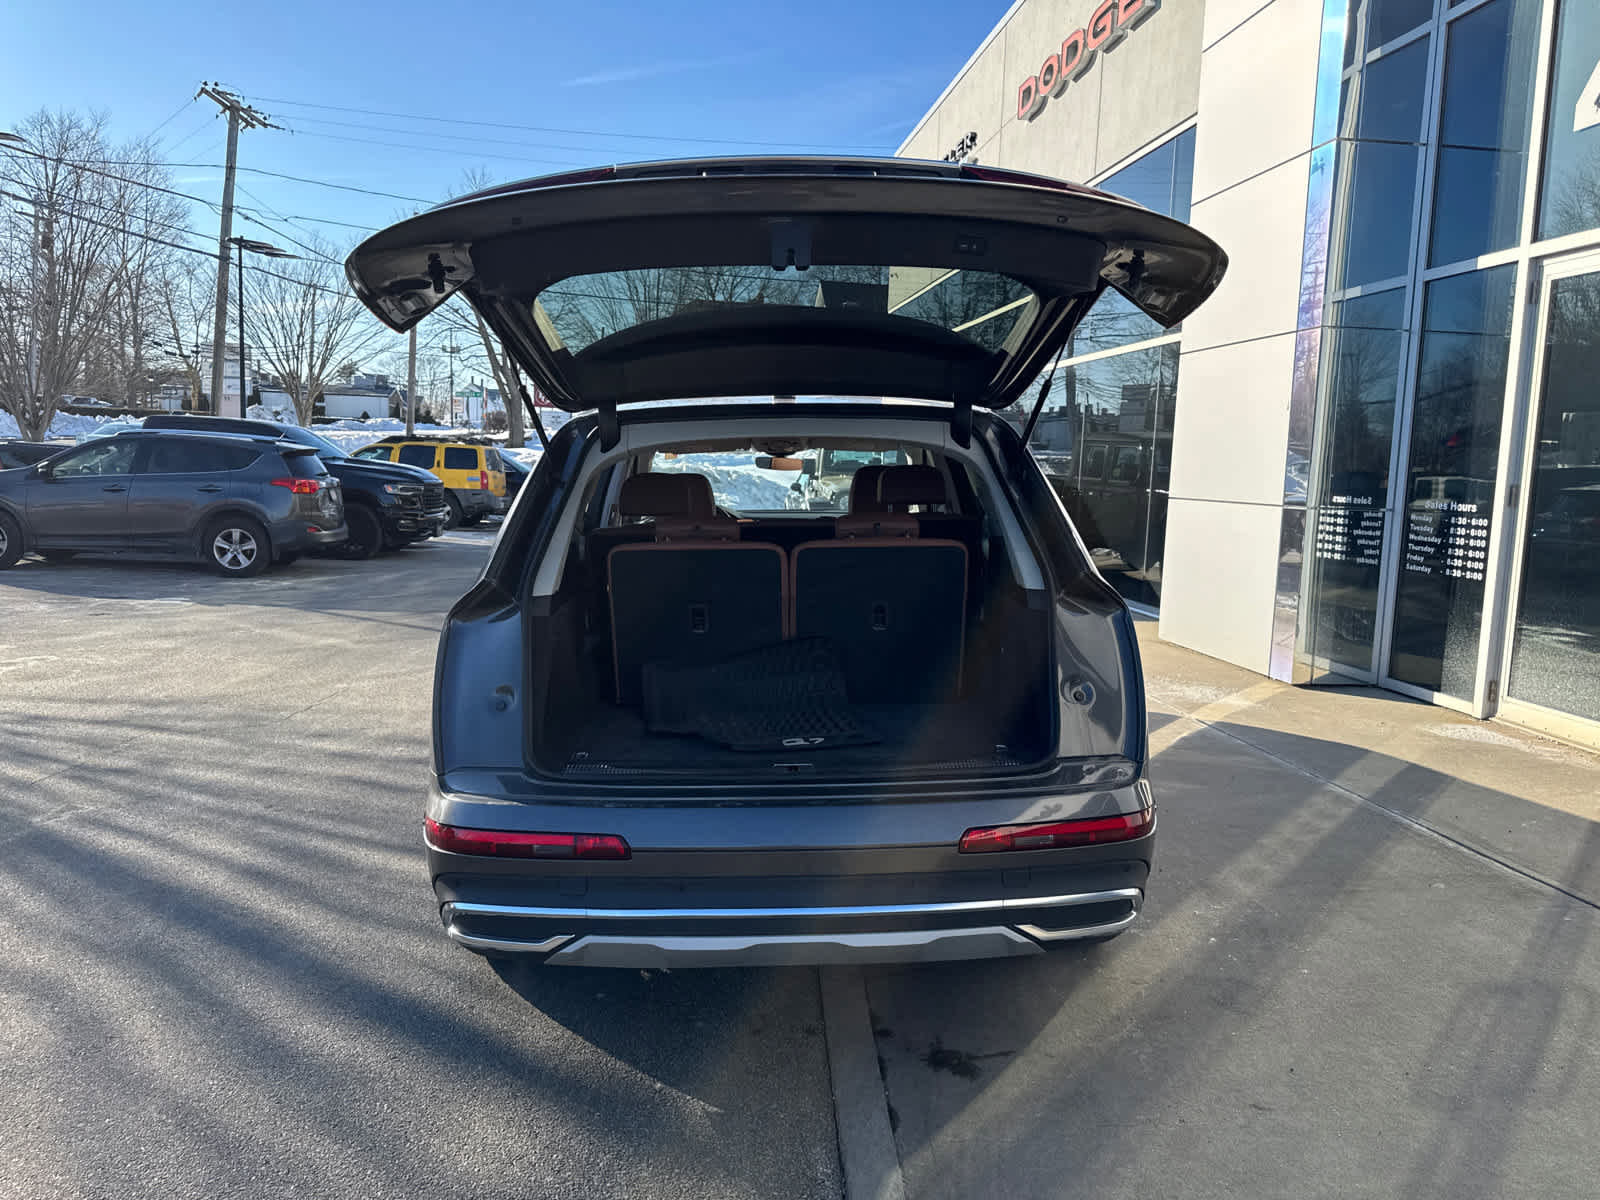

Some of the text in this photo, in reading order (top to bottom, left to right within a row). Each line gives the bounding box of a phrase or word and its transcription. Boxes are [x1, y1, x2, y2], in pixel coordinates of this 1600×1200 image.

[1424, 500, 1477, 512] Sales Hours
[1410, 523, 1434, 533] Tuesday
[1408, 533, 1442, 544] Wednesday
[1408, 543, 1435, 554] Thursday
[1405, 563, 1432, 574] Saturday
